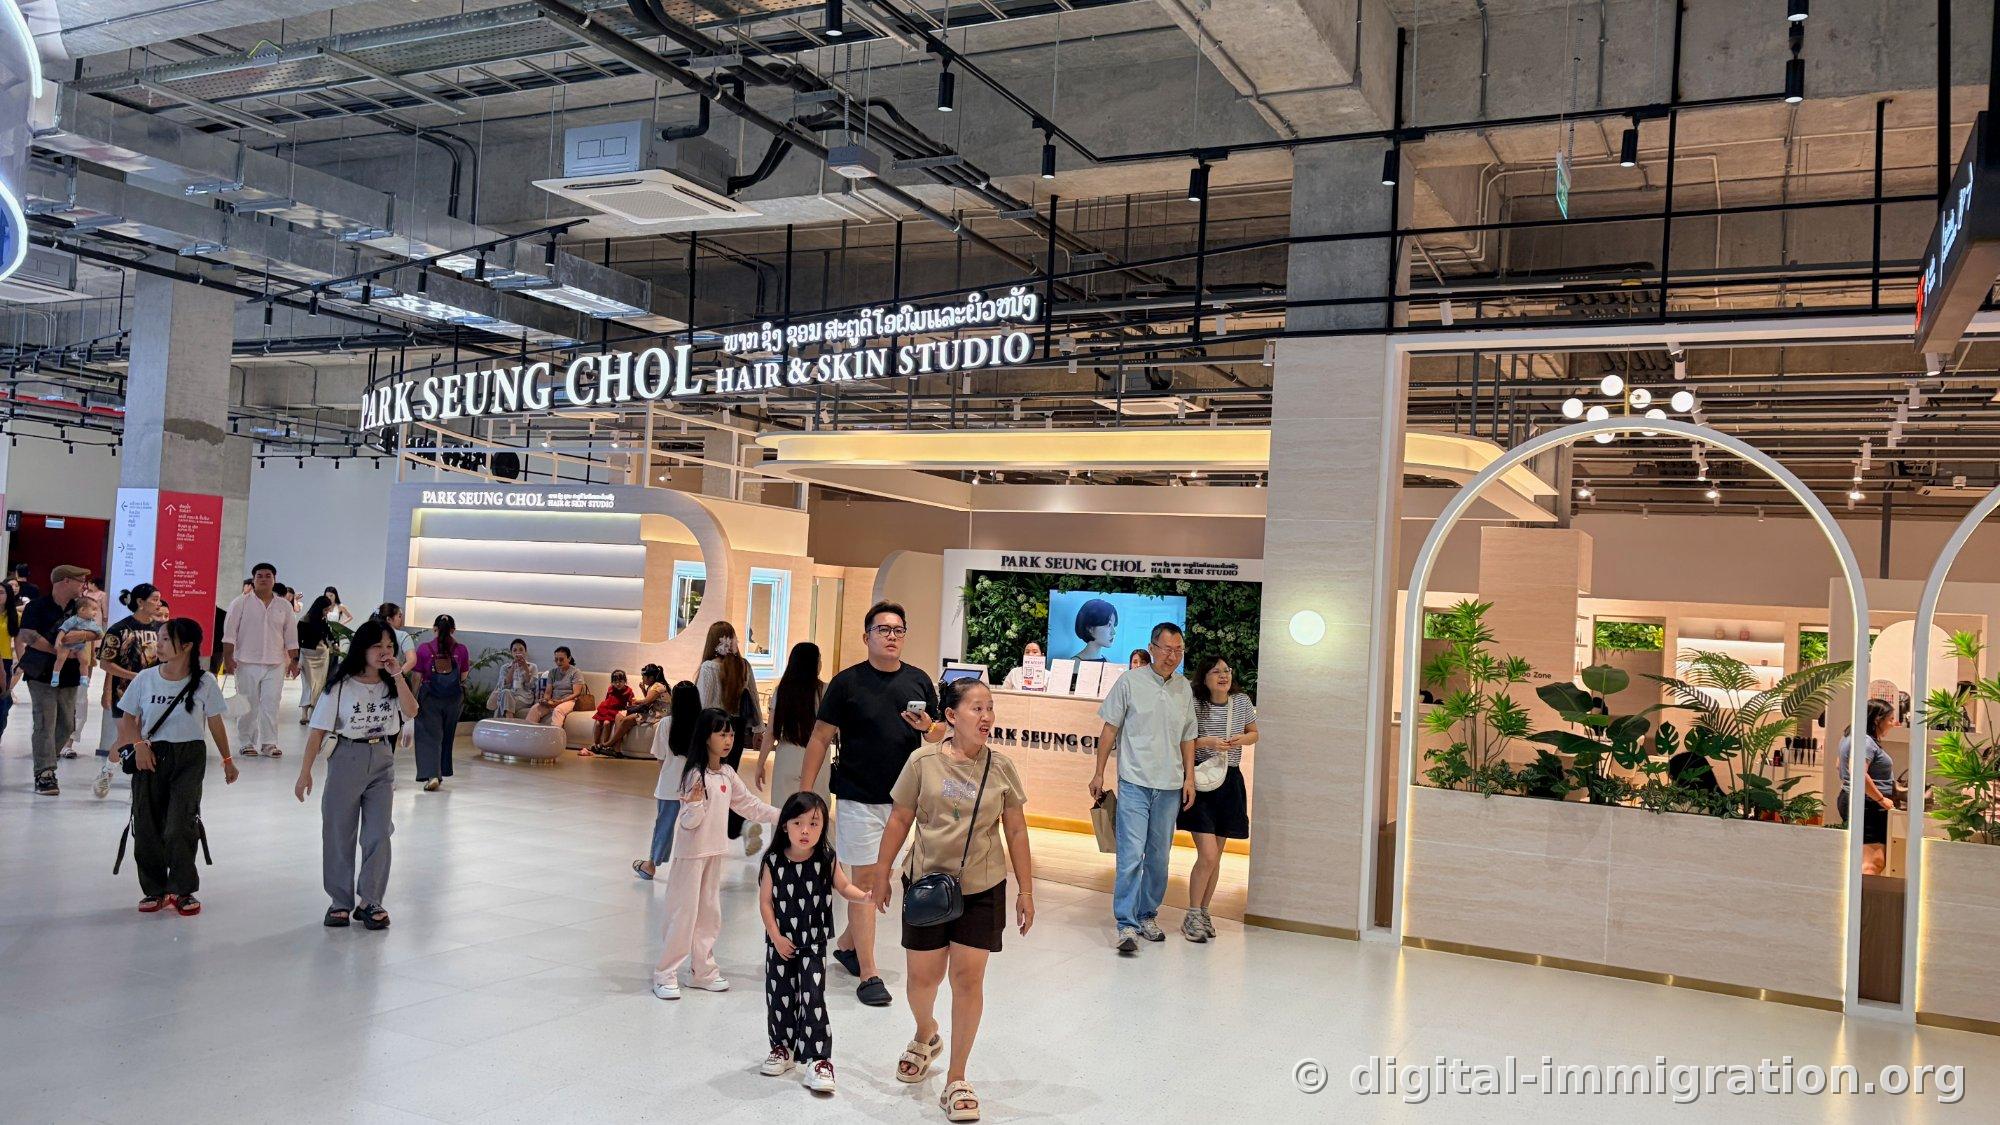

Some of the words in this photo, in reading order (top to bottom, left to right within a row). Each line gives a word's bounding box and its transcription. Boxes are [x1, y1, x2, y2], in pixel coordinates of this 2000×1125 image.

[724, 331, 759, 353] ພາກ
[715, 362, 782, 394] HAIR
[787, 357, 811, 385] &
[817, 348, 888, 383] SKIN
[898, 331, 1031, 375] STUDIO
[360, 381, 417, 432] PARK
[421, 362, 552, 421] SEUNG
[565, 344, 704, 406] CHOL
[422, 490, 456, 505] PARK
[458, 491, 504, 506] SEUNG
[505, 493, 546, 507] CHOL
[588, 500, 615, 508] STUDIO
[1001, 555, 1041, 568] PARK
[1045, 557, 1097, 571] SEUNG
[1101, 559, 1146, 573] CHOL
[1533, 671, 1552, 679] Zone
[1021, 729, 1078, 746] SEUNG
